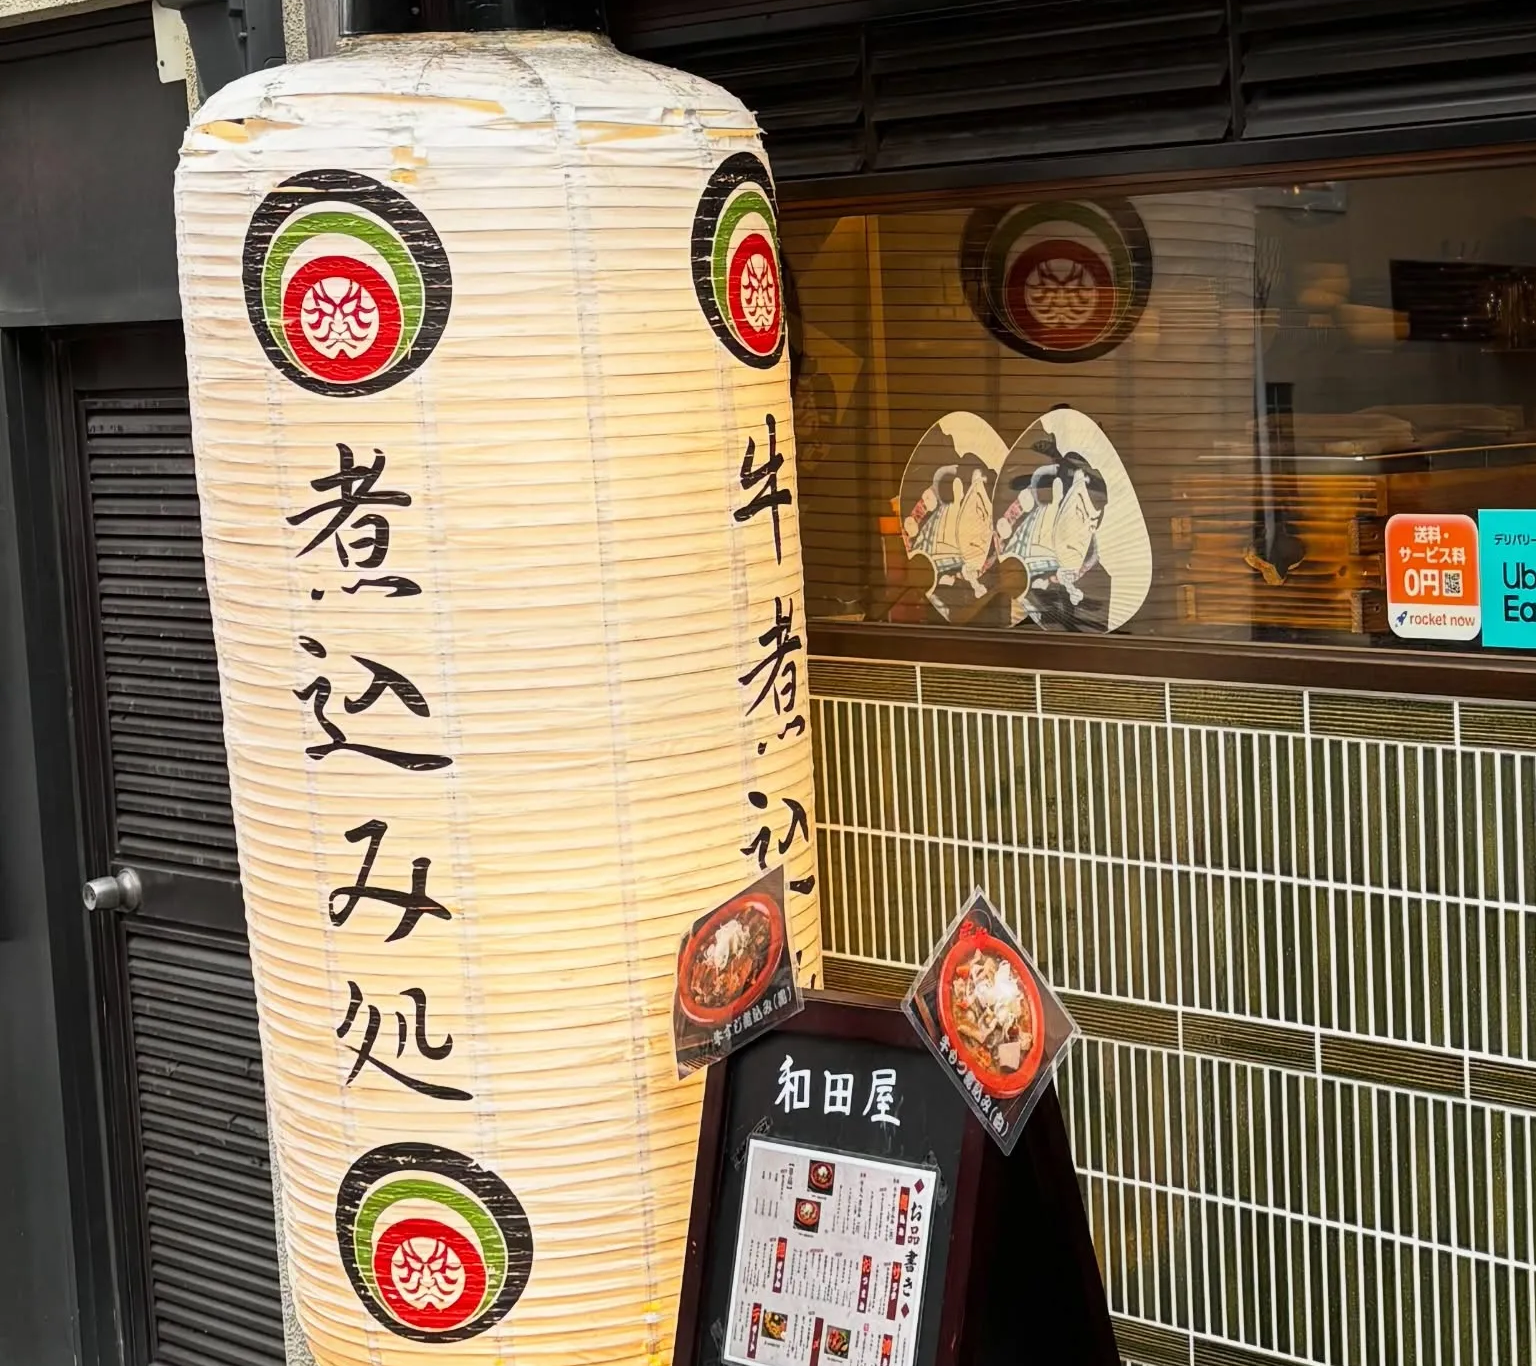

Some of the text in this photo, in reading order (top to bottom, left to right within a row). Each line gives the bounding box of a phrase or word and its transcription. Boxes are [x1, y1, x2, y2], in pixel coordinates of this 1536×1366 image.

[1398, 546, 1466, 565] サービス料
[1404, 568, 1440, 597] 0円
[1409, 613, 1476, 627] rocket now
[733, 412, 815, 987] 牛煮込
[284, 441, 474, 1103] 煮込み処
[775, 1054, 902, 1127] 和田屋
